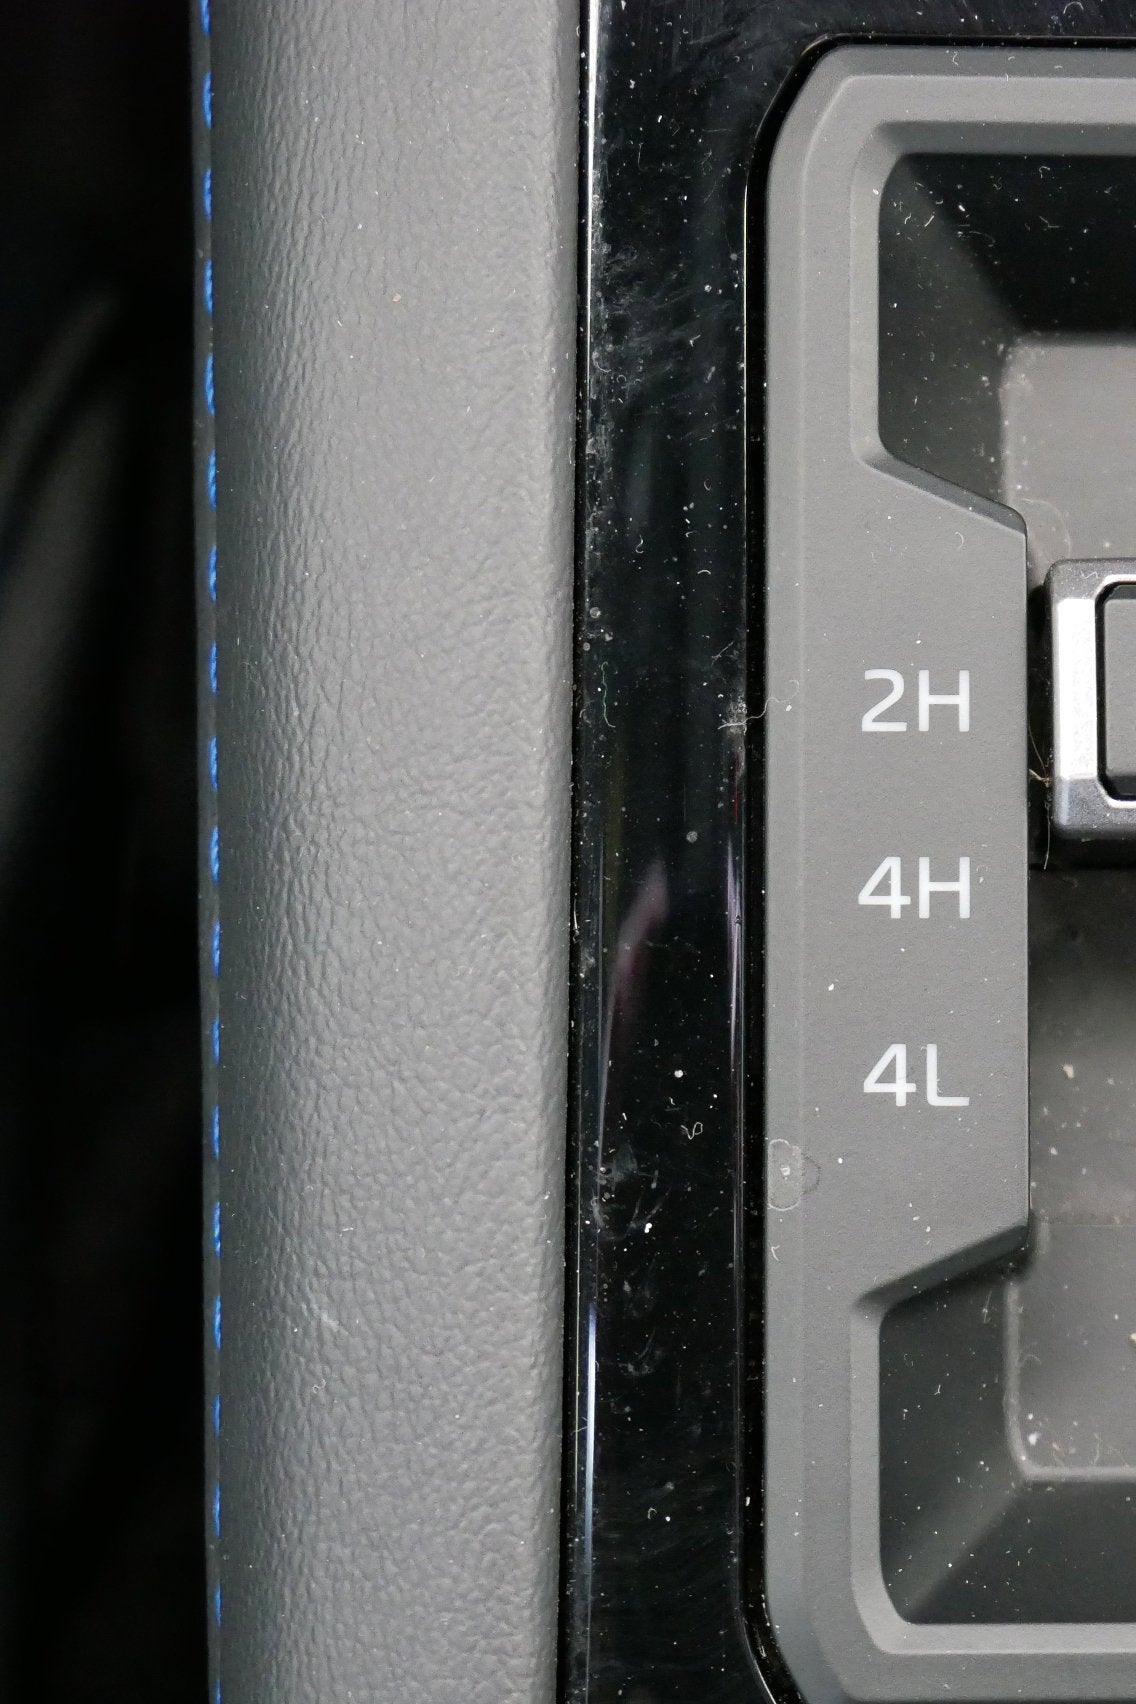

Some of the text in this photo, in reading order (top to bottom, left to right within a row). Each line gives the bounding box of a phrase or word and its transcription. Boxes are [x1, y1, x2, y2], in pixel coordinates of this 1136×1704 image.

[861, 668, 971, 733] 2H
[858, 856, 972, 920] 4H
[863, 1043, 970, 1108] 4L
